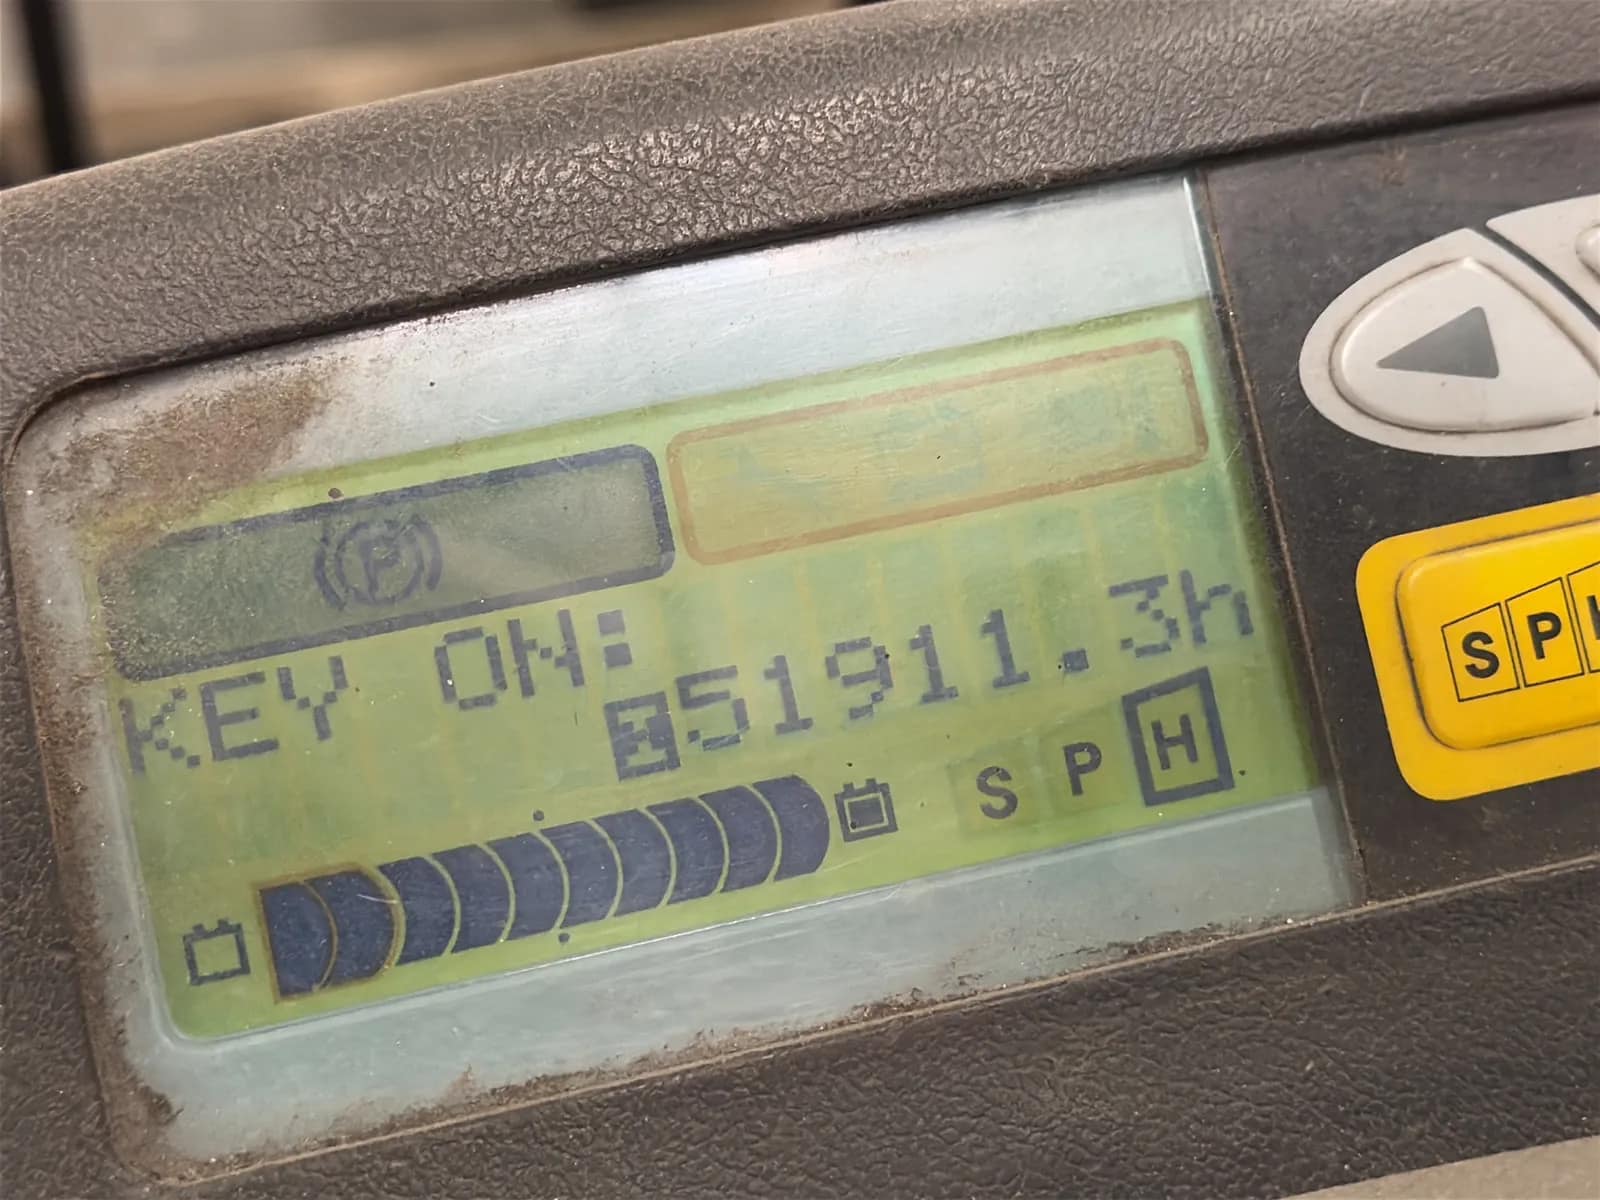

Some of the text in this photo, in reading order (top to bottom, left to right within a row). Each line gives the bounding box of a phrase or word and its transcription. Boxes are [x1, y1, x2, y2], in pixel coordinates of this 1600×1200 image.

[119, 609, 634, 773] KEY ON:
[976, 714, 1199, 820] S P H
